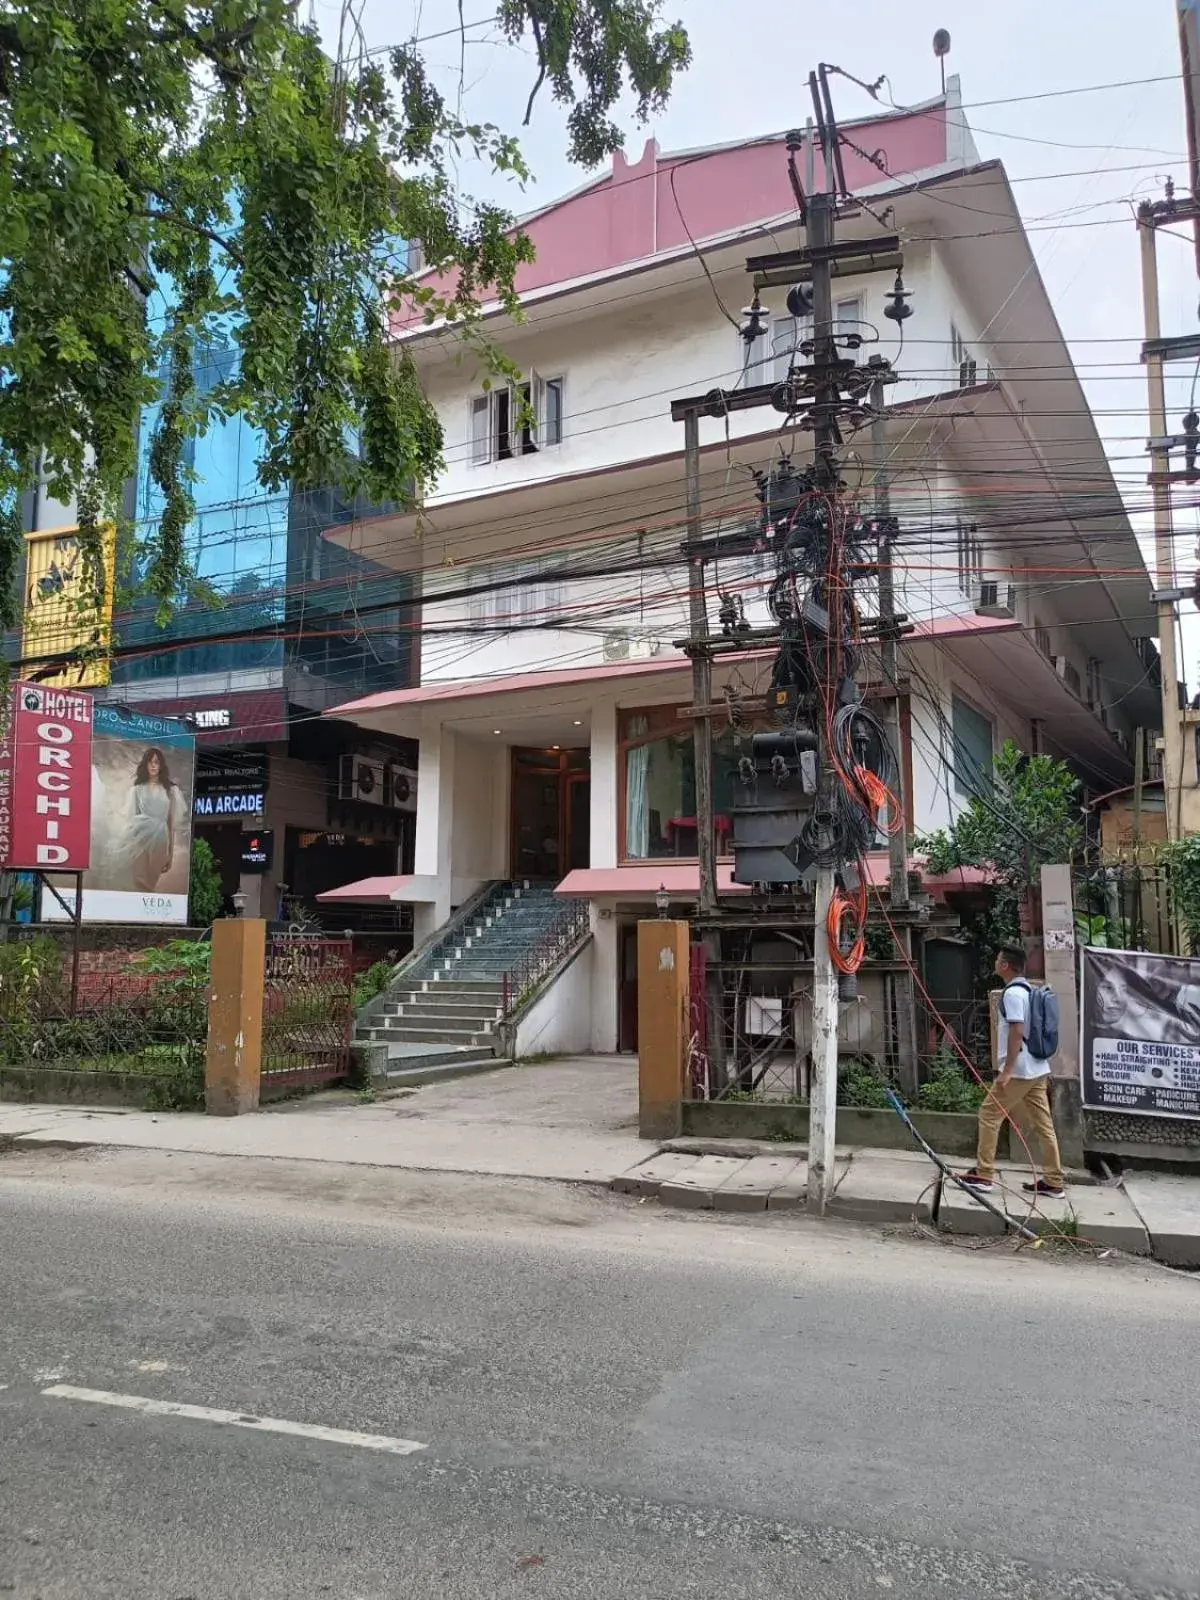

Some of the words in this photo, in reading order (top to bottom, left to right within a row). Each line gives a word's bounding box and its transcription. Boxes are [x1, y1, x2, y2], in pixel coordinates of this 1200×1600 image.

[46, 692, 90, 723] HOTEL
[195, 709, 230, 728] KING
[36, 722, 73, 864] ORCHID
[195, 797, 213, 815] NA
[216, 794, 263, 813] ARCADE
[0, 768, 11, 863] RESTAURANT
[142, 897, 172, 908] VEDA
[1117, 1041, 1139, 1055] OUR
[1142, 1043, 1194, 1059] SERVICES
[1101, 1053, 1119, 1062] HAIR
[1101, 1061, 1146, 1073] SMOOTHING
[1101, 1071, 1131, 1080] COLOUR
[1103, 1084, 1123, 1095] SKIN
[1125, 1086, 1147, 1097] CARE
[1103, 1094, 1138, 1105] MAKEUP
[1155, 1099, 1200, 1111] MANICURE
